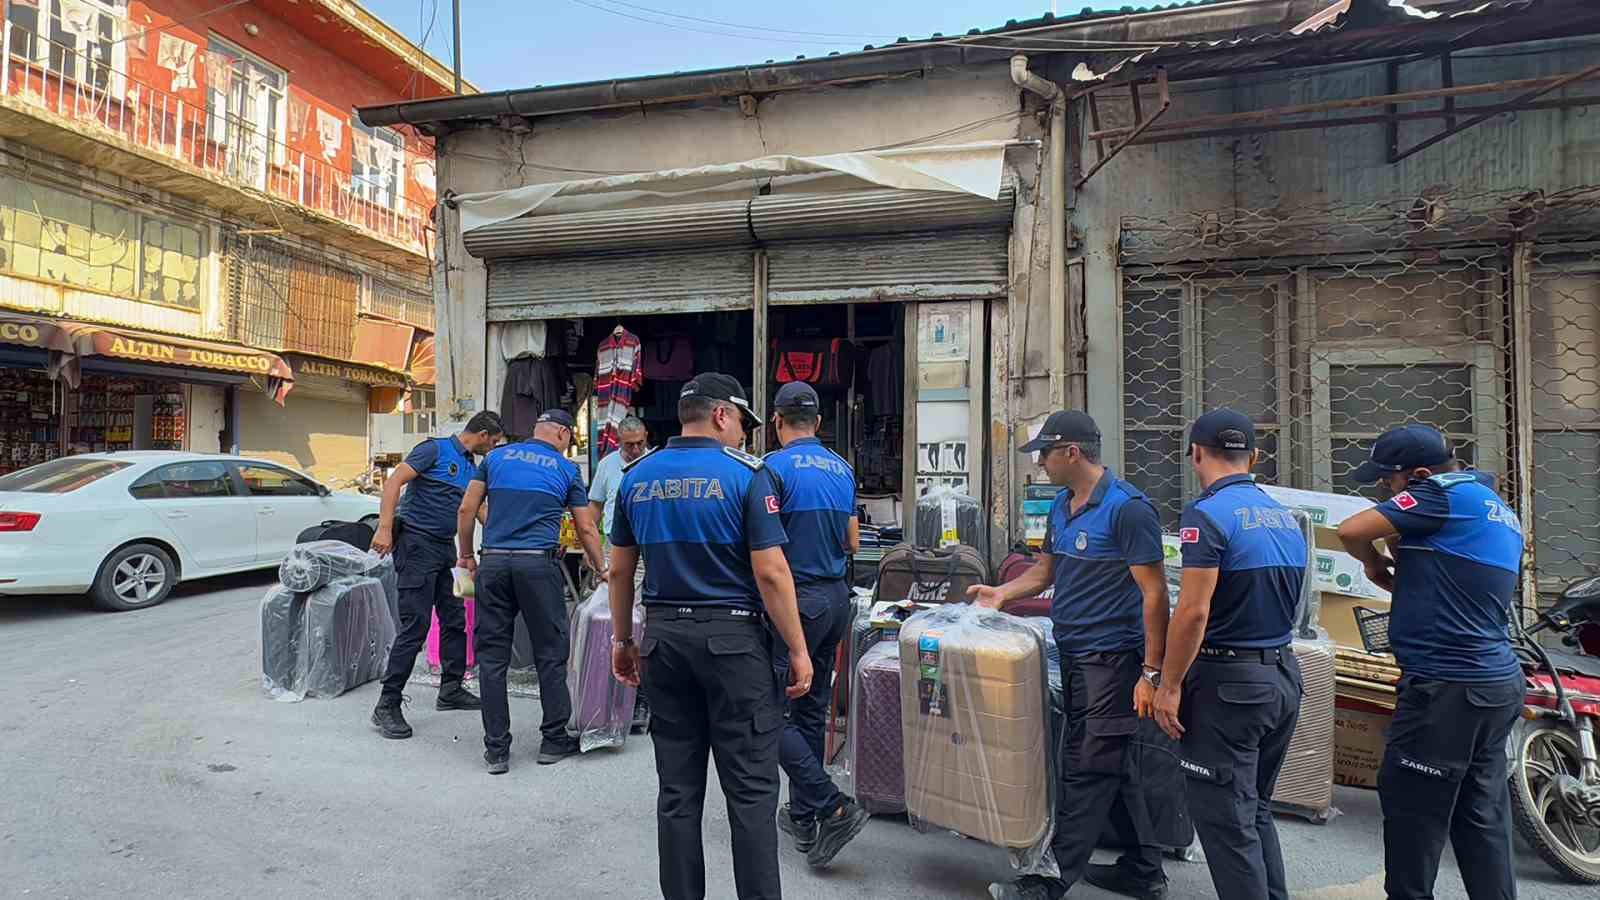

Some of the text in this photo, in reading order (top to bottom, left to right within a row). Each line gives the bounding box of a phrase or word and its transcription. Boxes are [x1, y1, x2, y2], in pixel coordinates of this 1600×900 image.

[110, 337, 270, 370] ALTIN TOBACCO
[301, 361, 400, 385] ALTIN TOBACCO
[503, 449, 559, 470] ZABITA
[632, 478, 725, 502] ZABITA
[907, 582, 951, 600] NIKE
[1180, 759, 1210, 776] ZABITA
[1400, 758, 1442, 776] ZABITA
